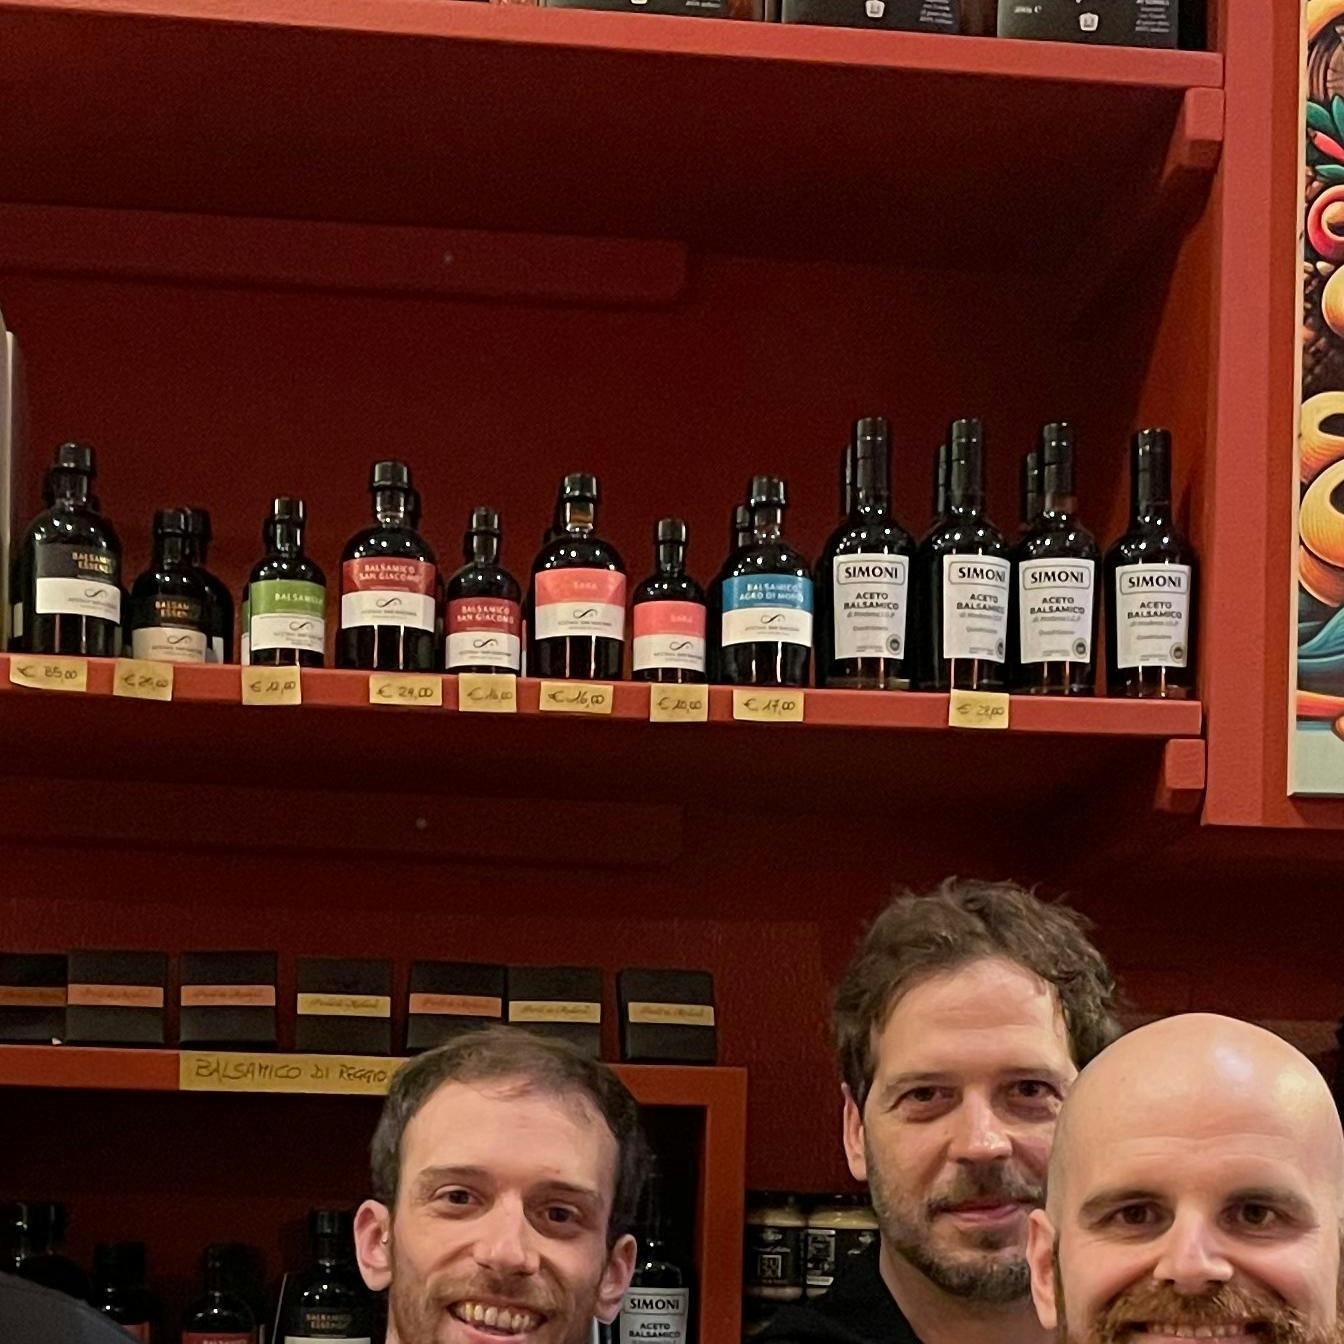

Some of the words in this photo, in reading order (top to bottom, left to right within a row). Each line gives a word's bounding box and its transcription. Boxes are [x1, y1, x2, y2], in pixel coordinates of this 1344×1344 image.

[364, 564, 416, 574] BALSAMICO
[844, 566, 898, 578] SIMONI
[958, 567, 1006, 582] SIMONI
[1031, 571, 1084, 584] SIMONI
[1128, 576, 1182, 588] SIMONI
[856, 592, 888, 600] ACETO
[969, 593, 998, 603] ACETO
[1042, 597, 1074, 605] ACETO
[461, 604, 510, 616] BALSAMICO
[843, 602, 899, 610] BALSAMICO
[1030, 607, 1085, 615] BALSAMICO
[1139, 602, 1172, 610] ACETO
[1127, 612, 1182, 620] BALSAMICO
[377, 684, 393, 699] €
[657, 697, 670, 711] €
[744, 697, 758, 712] €
[195, 1058, 301, 1083] BALSAMICO
[311, 1063, 329, 1080] DI
[338, 1064, 387, 1084] REGGIO
[630, 1298, 680, 1310] SIMONI
[640, 1322, 671, 1330] ACETO
[629, 1330, 681, 1338] BALSAMICO
